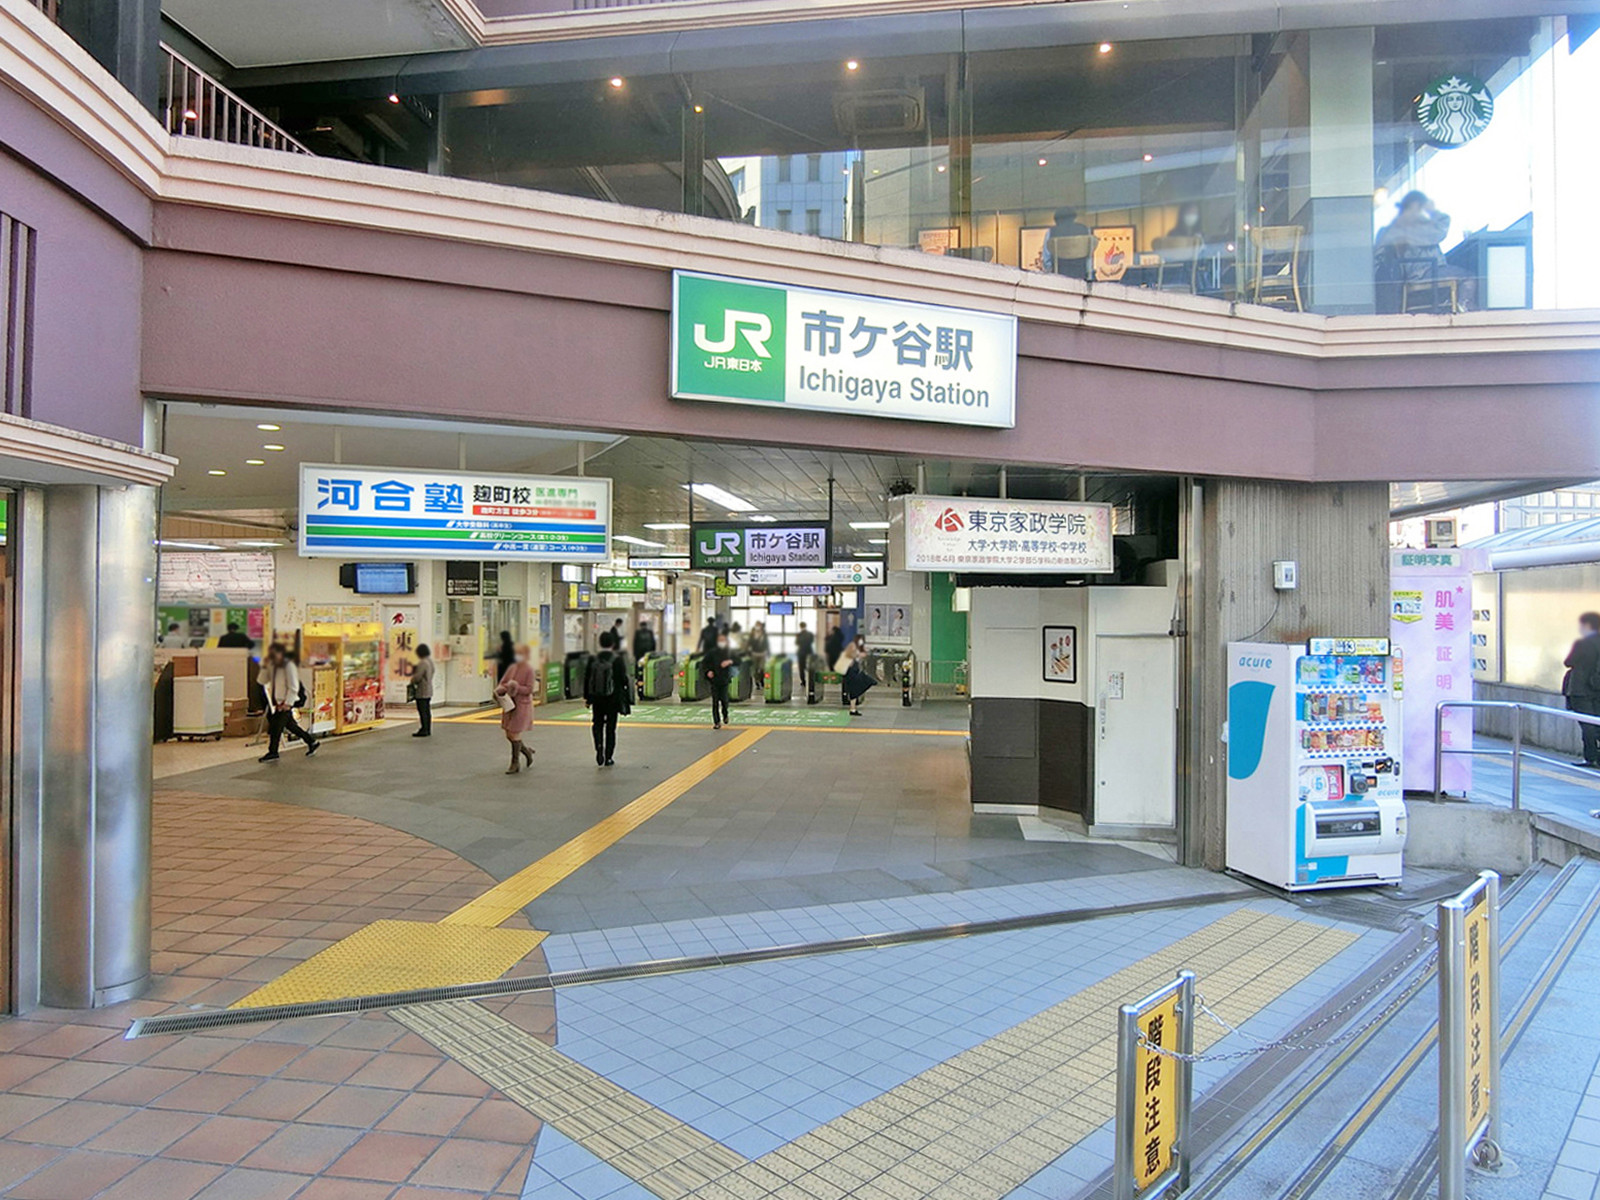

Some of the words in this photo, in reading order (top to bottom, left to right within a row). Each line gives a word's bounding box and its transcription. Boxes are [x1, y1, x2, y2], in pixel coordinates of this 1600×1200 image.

[693, 308, 772, 359] JR
[704, 355, 763, 373] JR東日本
[799, 365, 901, 403] Ichigaya
[909, 377, 990, 408] Station
[317, 478, 464, 514] 河合塾
[968, 510, 1087, 535] 東京家政学院
[700, 532, 741, 556] JR
[749, 553, 786, 564] Ichigaya
[789, 551, 820, 562] Station
[915, 554, 956, 563] 2018年4月
[1401, 554, 1453, 567] 証明写真
[394, 631, 416, 677] 東北
[1238, 656, 1273, 669] acure
[1144, 1014, 1164, 1178] 階段注意
